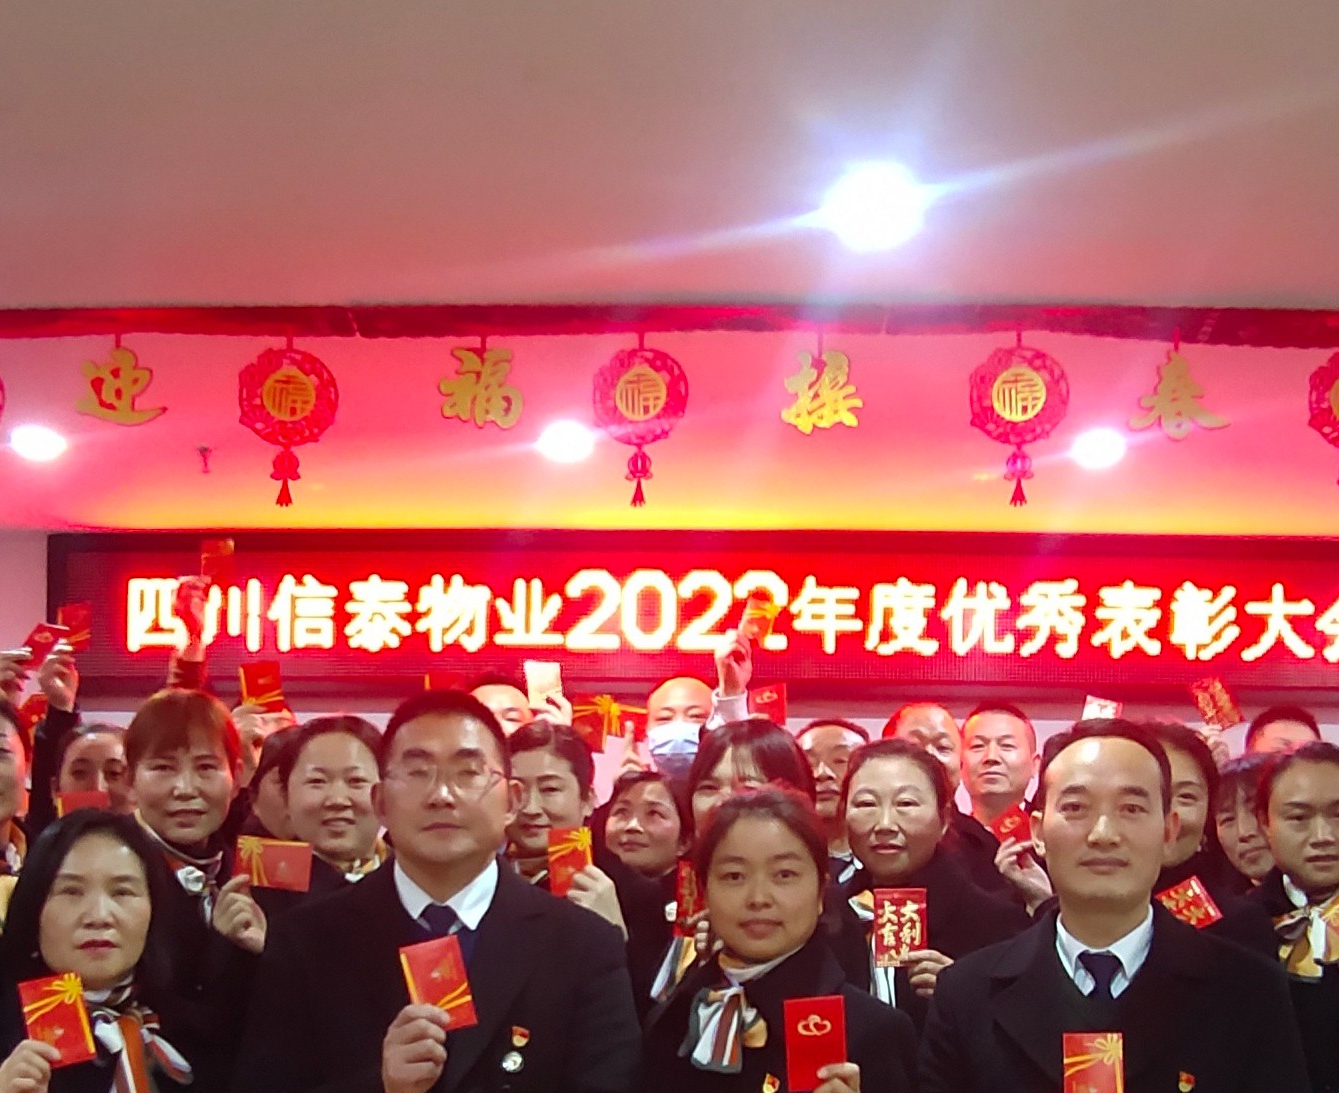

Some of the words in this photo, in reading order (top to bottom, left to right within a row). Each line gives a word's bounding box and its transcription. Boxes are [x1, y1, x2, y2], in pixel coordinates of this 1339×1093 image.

[76, 347, 169, 428] 迎
[439, 347, 524, 430] 福
[781, 350, 864, 435] 接
[1127, 351, 1230, 440] 春
